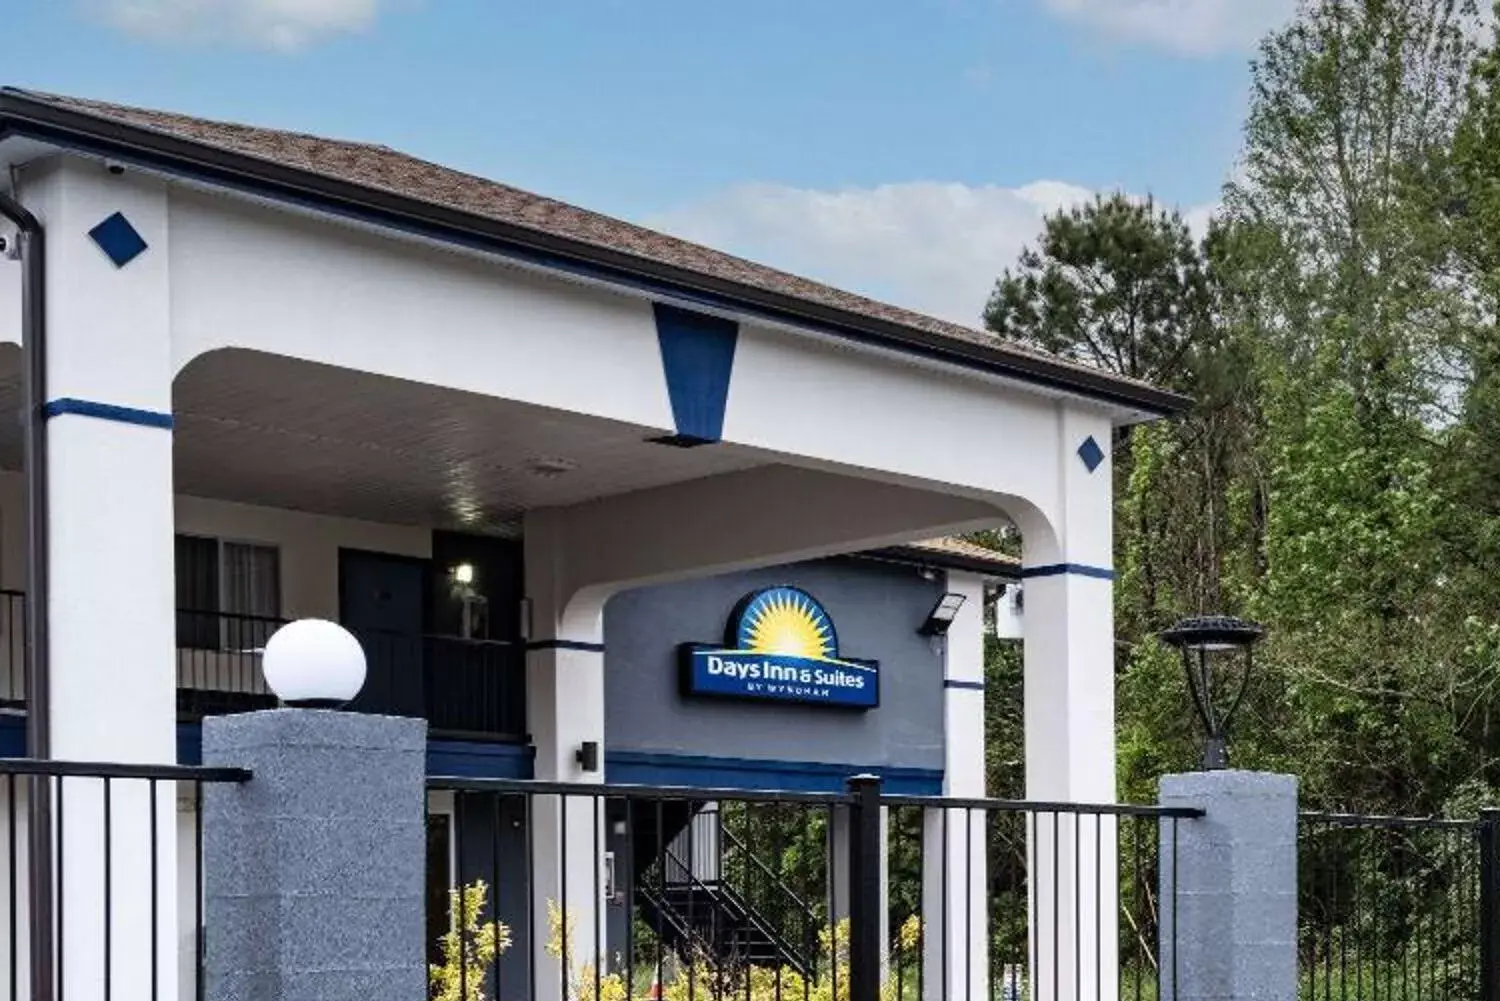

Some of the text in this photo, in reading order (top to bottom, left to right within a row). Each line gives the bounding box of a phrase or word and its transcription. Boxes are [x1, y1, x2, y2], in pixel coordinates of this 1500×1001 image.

[708, 656, 864, 688] Days Inn & Suites
